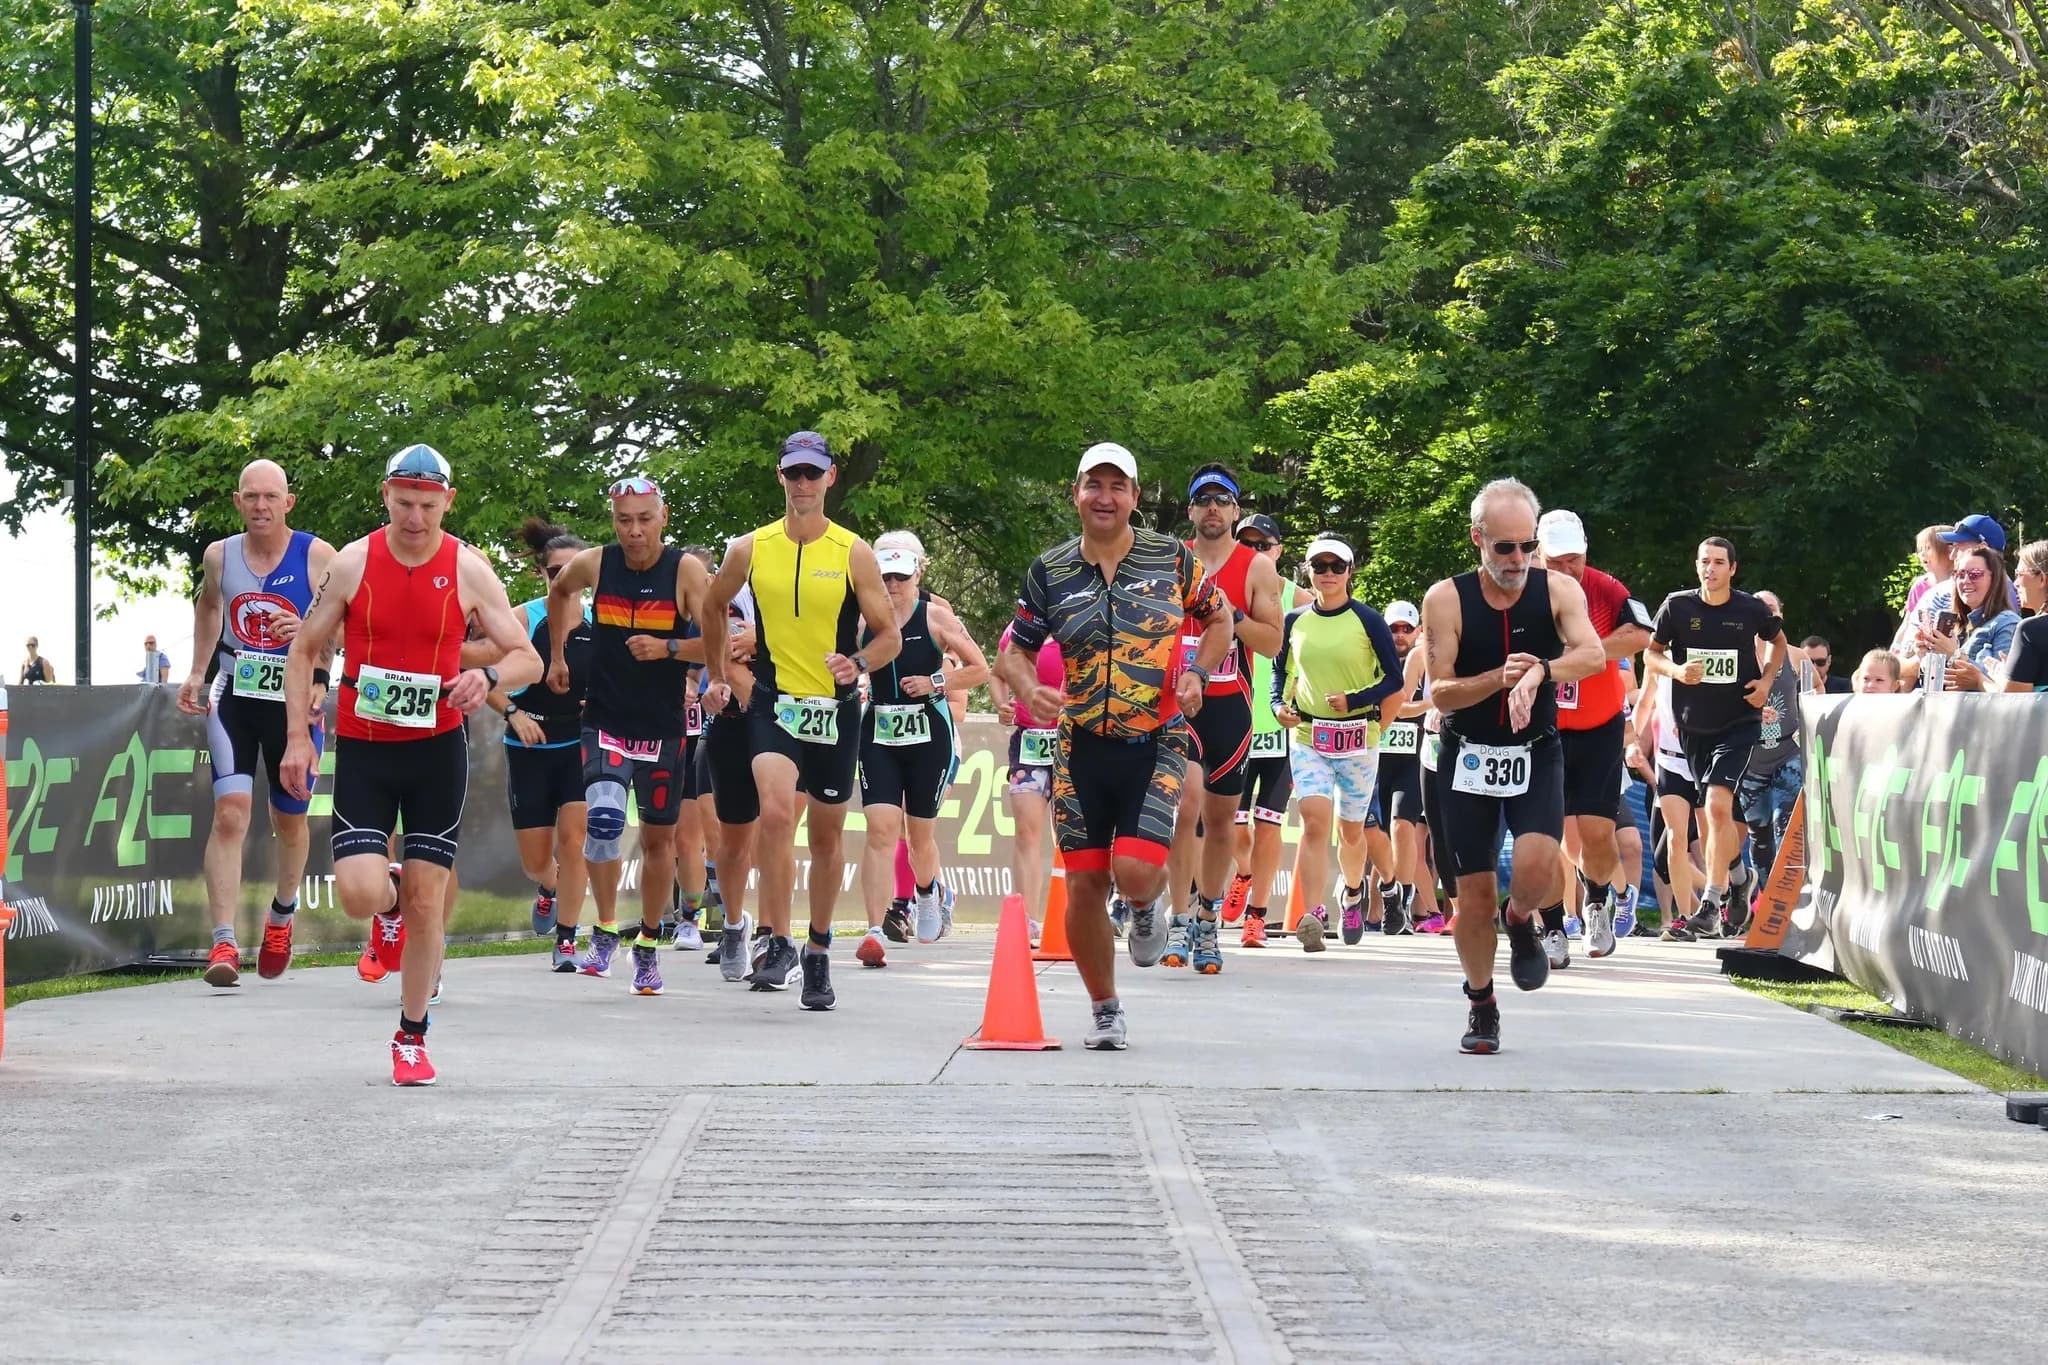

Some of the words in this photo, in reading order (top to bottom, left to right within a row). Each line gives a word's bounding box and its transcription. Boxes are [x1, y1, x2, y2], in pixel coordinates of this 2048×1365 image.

[258, 655, 288, 663] LEVESQ
[1706, 658, 1734, 677] 248
[258, 665, 285, 692] 25
[385, 673, 412, 683] BRIAN
[384, 685, 434, 717] 235
[798, 708, 834, 737] 237
[892, 714, 926, 738] 241
[1253, 730, 1282, 750] 251
[1334, 729, 1363, 751] 078
[1389, 730, 1415, 747] 233
[1484, 756, 1526, 786] 330
[90, 878, 174, 925] NUTRITION
[1908, 924, 1969, 982] NUTRITION
[2009, 950, 2048, 1015] NUTRITIO
